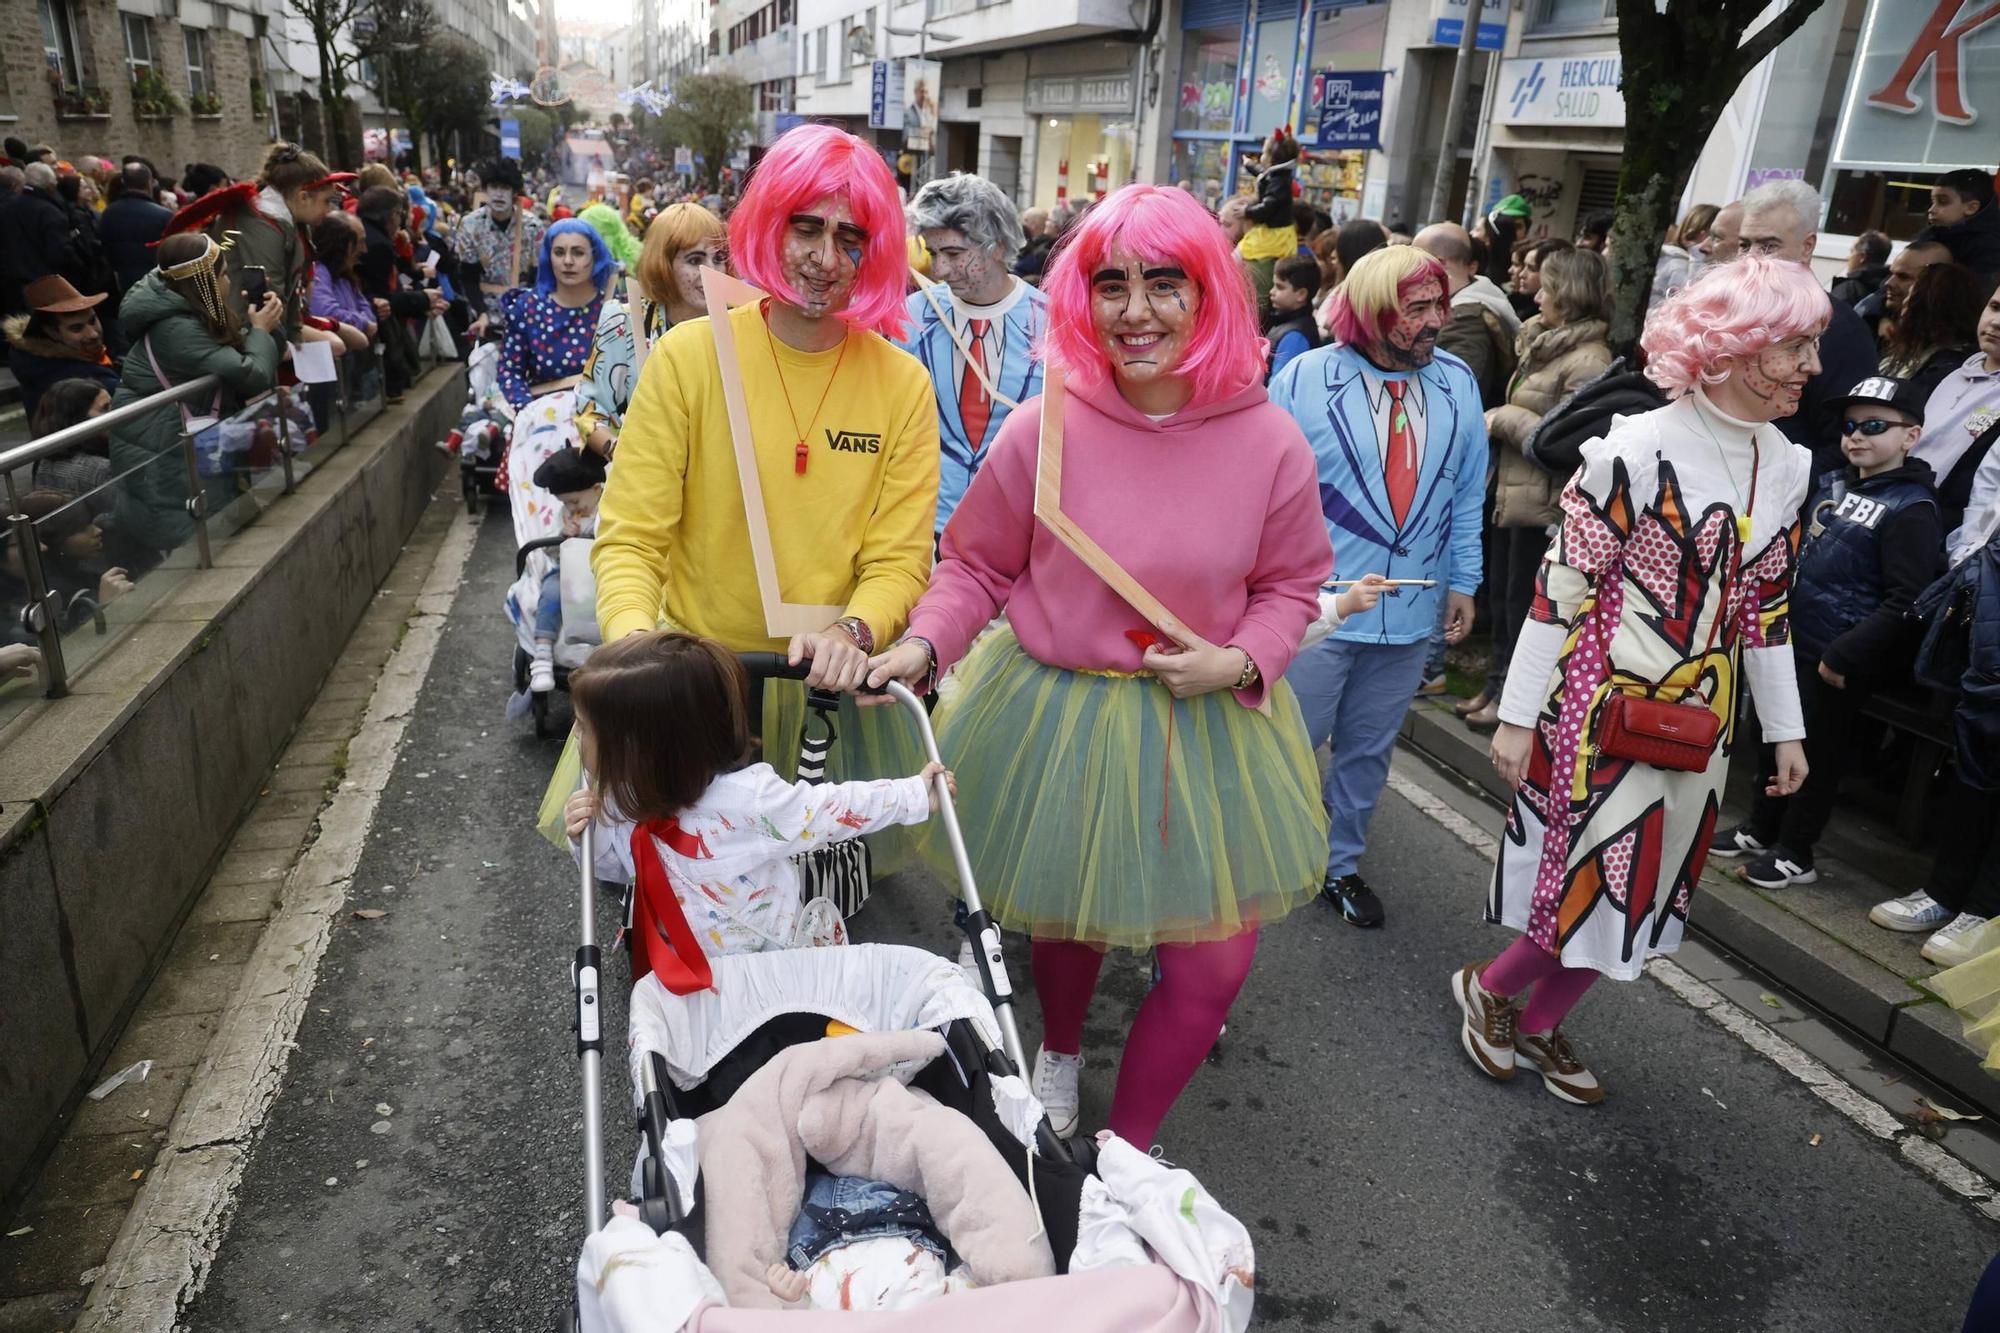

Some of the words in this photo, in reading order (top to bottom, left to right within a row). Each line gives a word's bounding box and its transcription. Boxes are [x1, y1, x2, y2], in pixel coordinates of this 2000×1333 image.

[1560, 60, 1623, 87] HERCUL
[1554, 91, 1600, 118] SALUD
[1848, 379, 1895, 401] FBI
[825, 429, 881, 453] VANS
[1835, 492, 1886, 528] FBI
